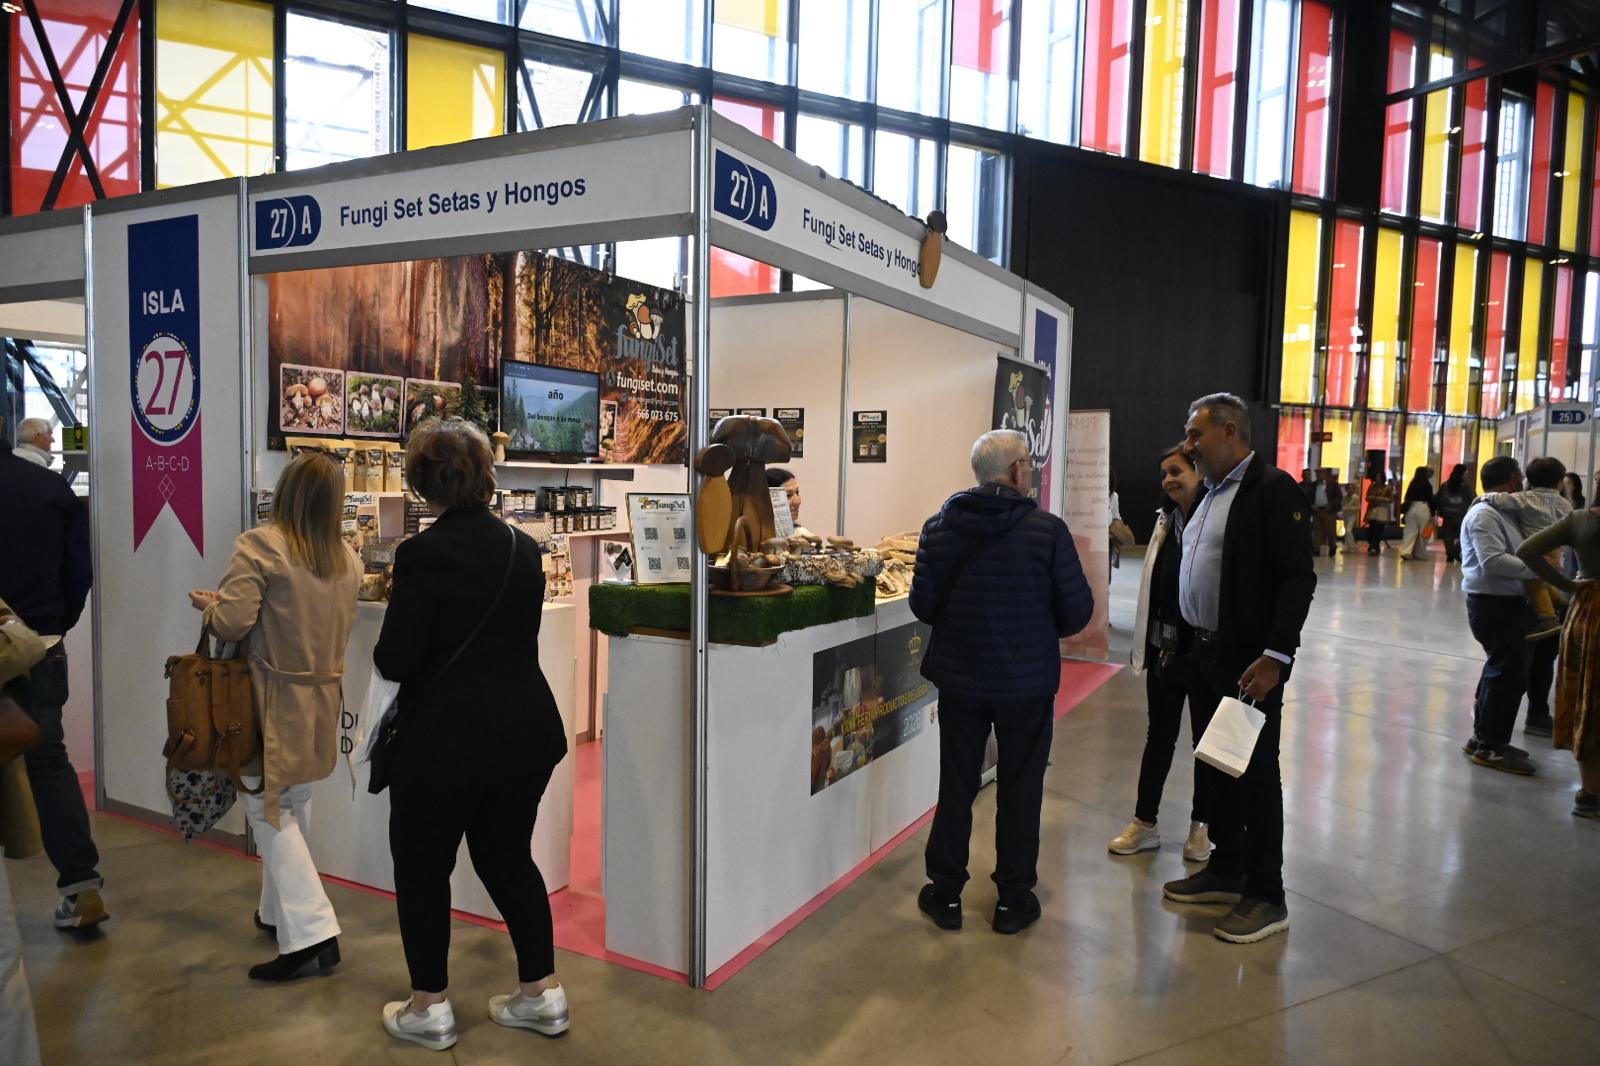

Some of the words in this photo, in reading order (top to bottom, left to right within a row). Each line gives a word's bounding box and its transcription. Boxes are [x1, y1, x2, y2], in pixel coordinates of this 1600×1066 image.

[340, 201, 388, 228] Fungi
[394, 197, 423, 220] Set
[428, 191, 480, 215] Setas
[486, 191, 498, 213] y
[505, 178, 586, 206] Hongos
[731, 170, 748, 210] 27
[760, 185, 768, 220] A
[270, 208, 288, 238] 27
[301, 205, 312, 235] A
[803, 208, 836, 244] Fungi
[838, 224, 855, 249] Set
[858, 233, 884, 260] Setas
[887, 249, 892, 267] y
[143, 288, 185, 315] ISLA
[145, 350, 187, 416] 27
[548, 389, 564, 400] año
[616, 371, 679, 395] fungiset.com
[651, 410, 664, 421] 073
[665, 411, 678, 422] 675
[145, 455, 190, 472] A-B-C-D
